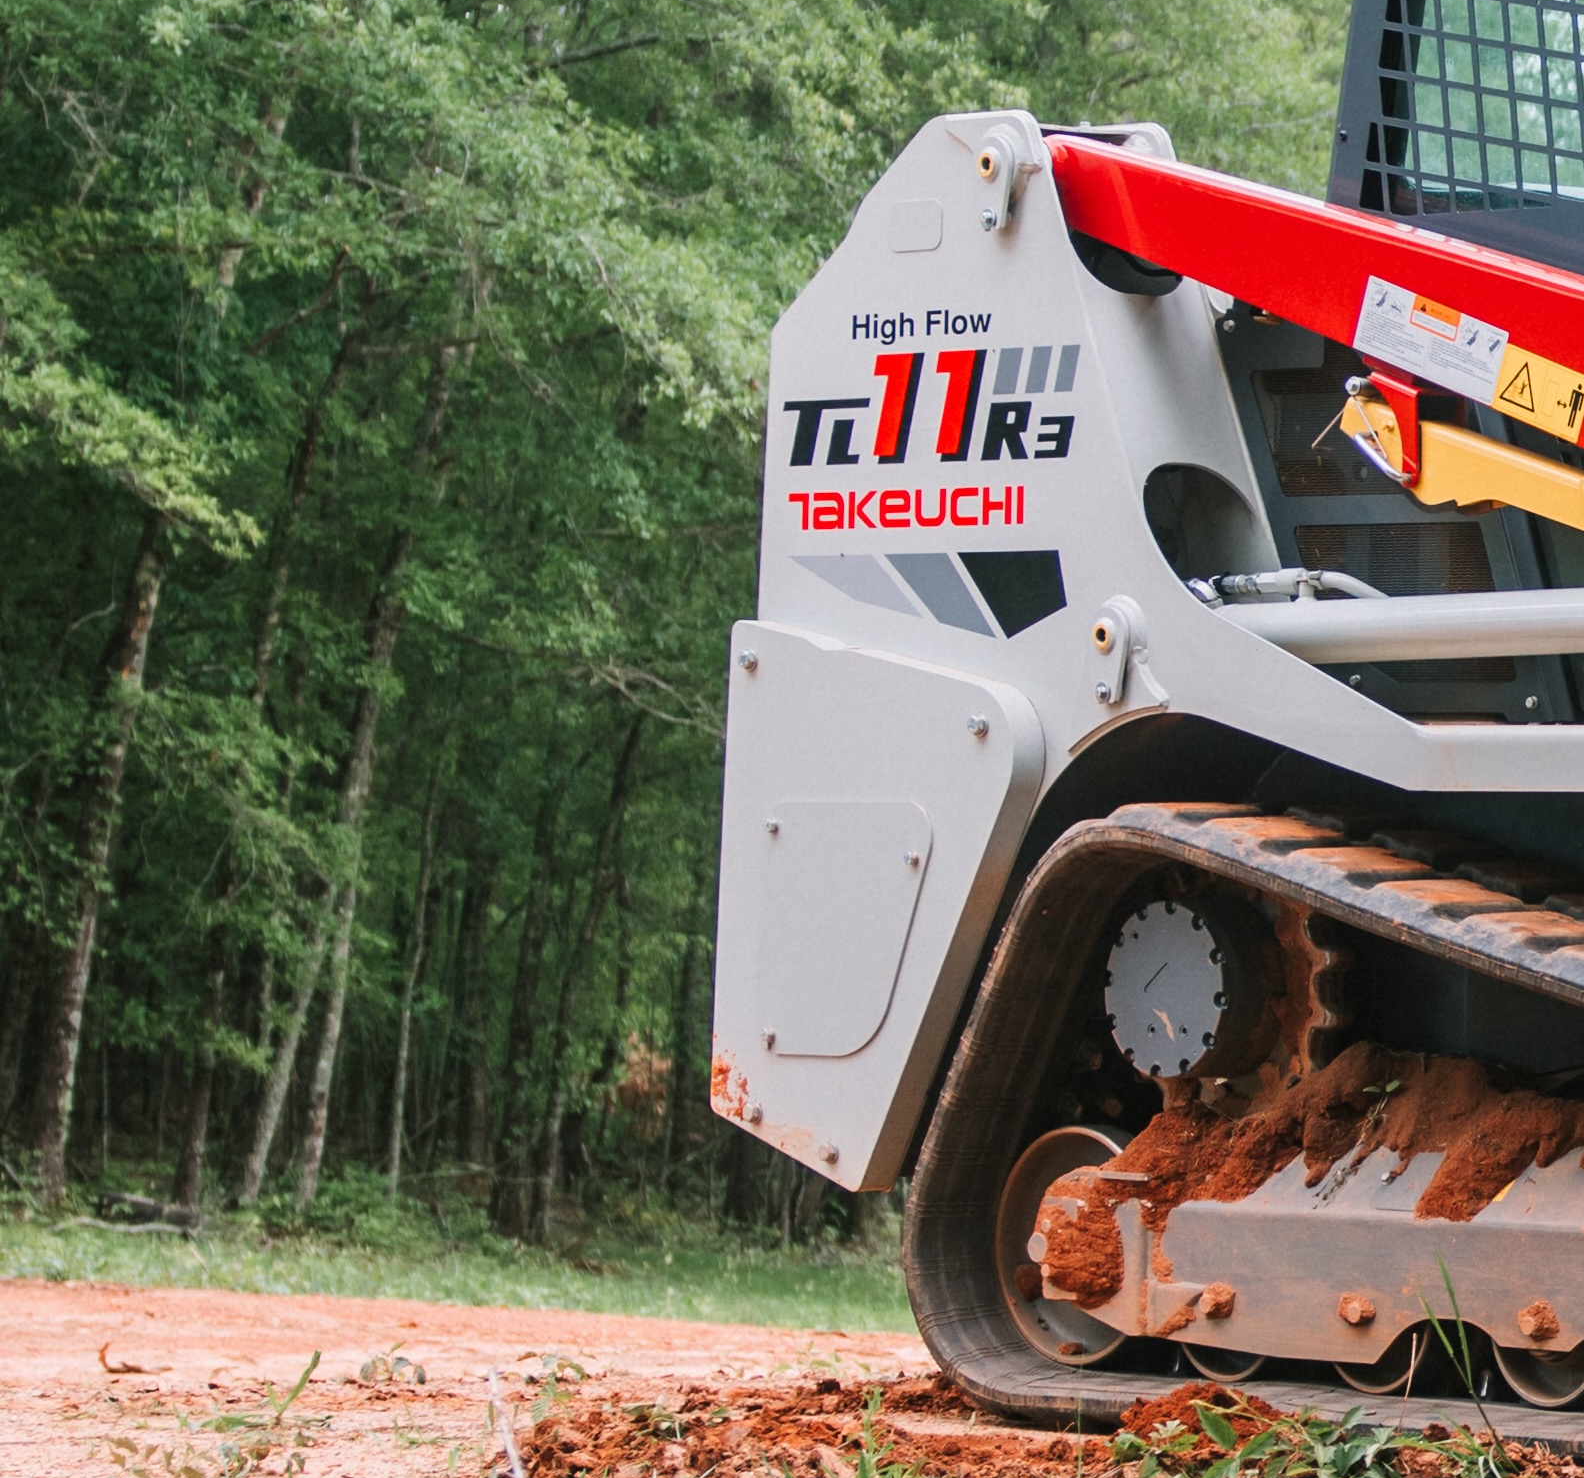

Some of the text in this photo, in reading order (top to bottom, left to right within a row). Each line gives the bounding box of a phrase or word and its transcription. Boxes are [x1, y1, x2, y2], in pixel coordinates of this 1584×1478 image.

[851, 309, 992, 345] High Flow
[788, 486, 1025, 531] TAKEUCHI
